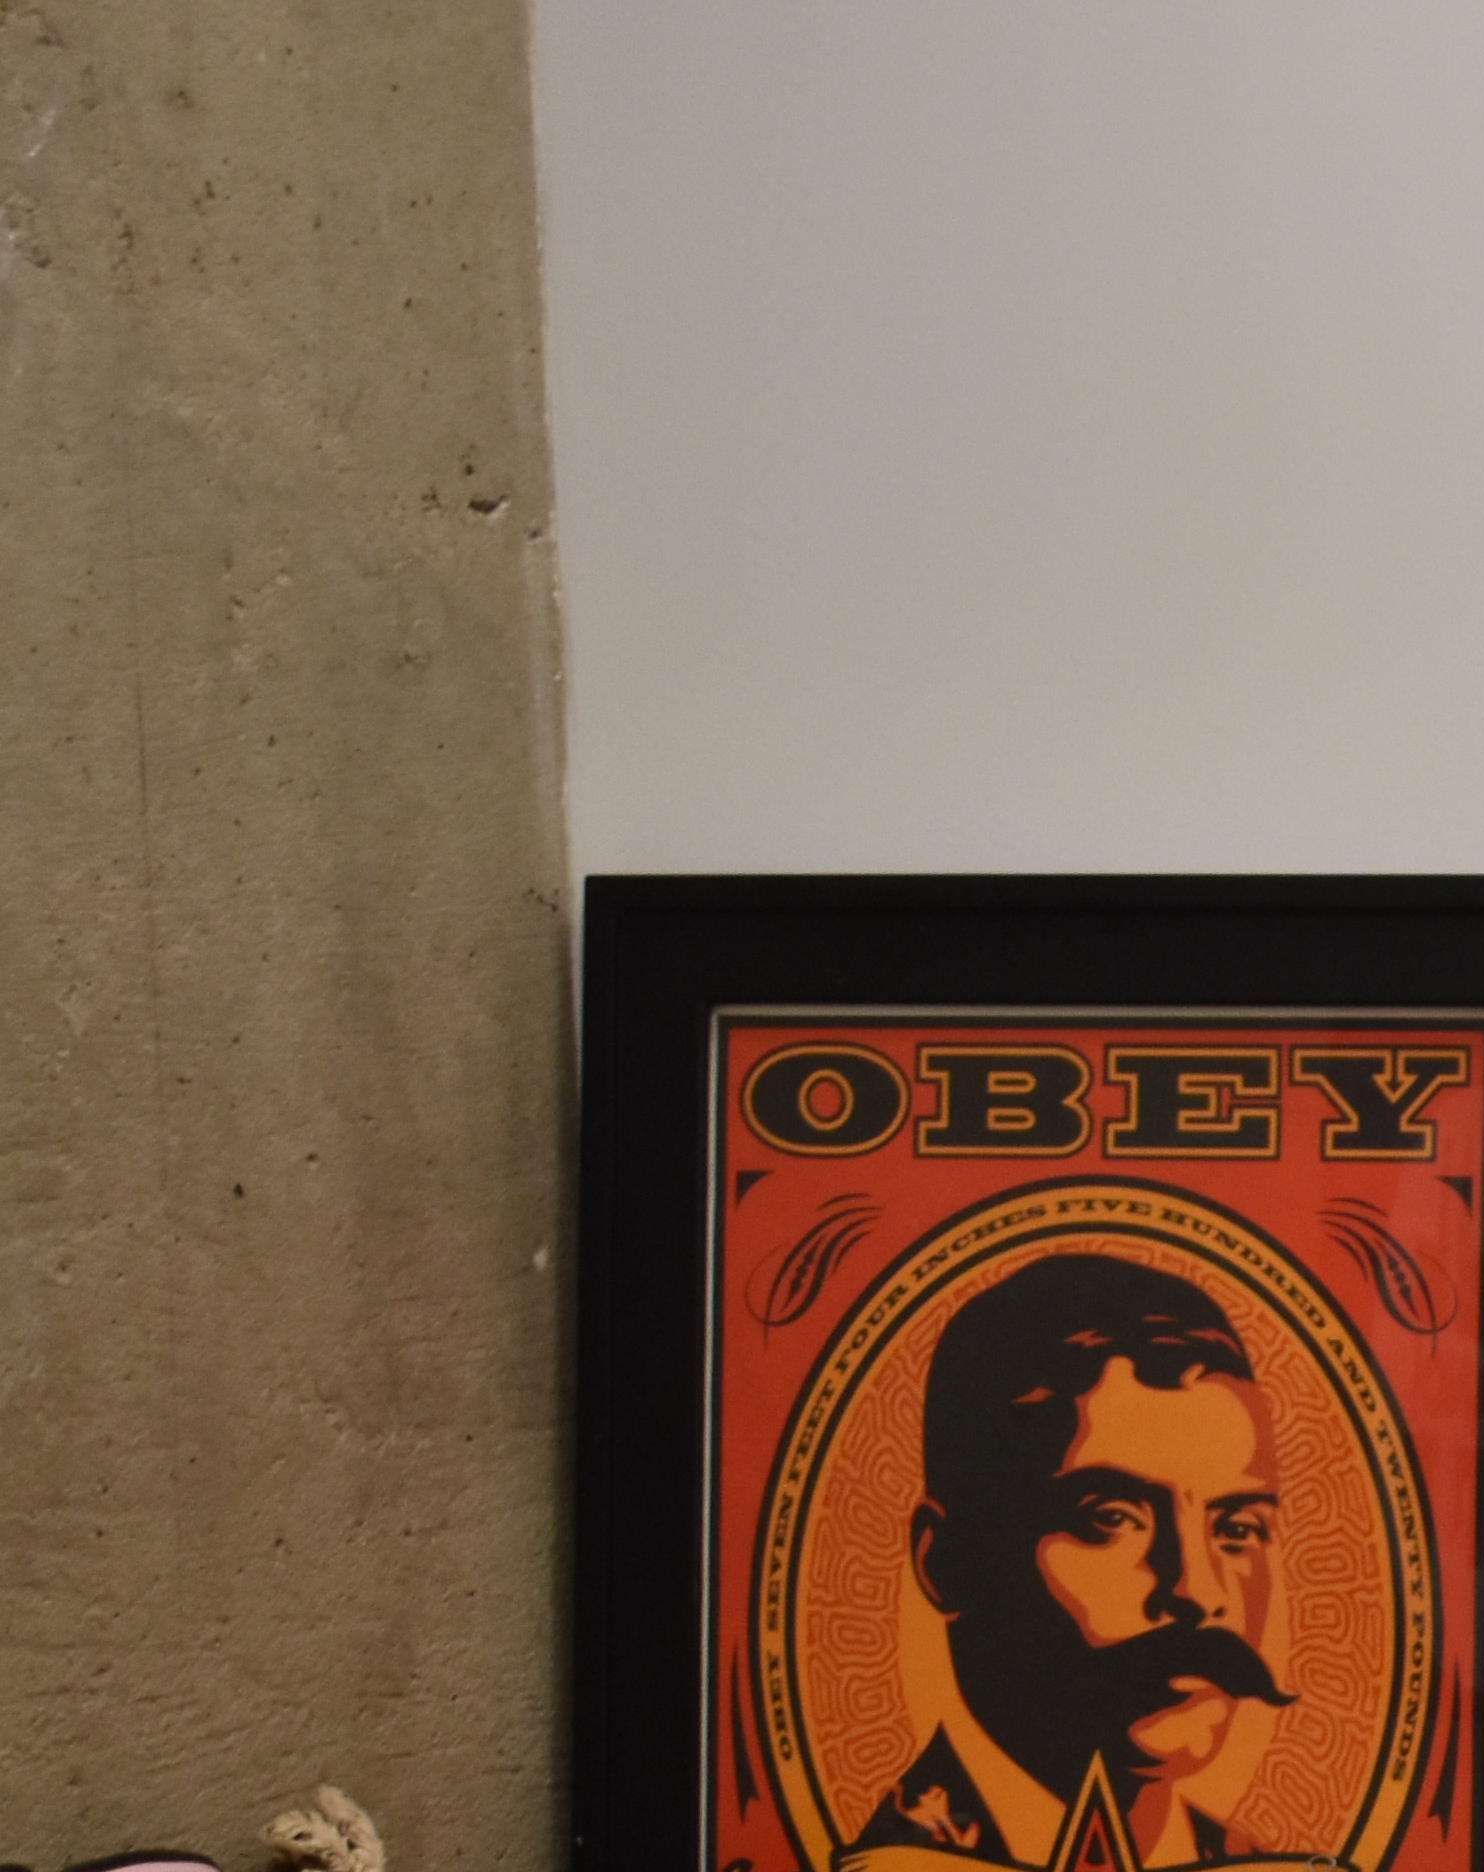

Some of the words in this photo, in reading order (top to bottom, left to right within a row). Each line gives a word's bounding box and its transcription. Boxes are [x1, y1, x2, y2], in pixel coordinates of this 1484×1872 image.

[740, 1040, 1472, 1161] OBEY
[910, 1202, 1047, 1283] INCHES
[1056, 1198, 1153, 1217] FIVE
[1160, 1205, 1327, 1331] HUNDRED
[834, 1282, 908, 1376] FOUR
[1328, 1338, 1378, 1414] AND
[790, 1380, 835, 1486] FEET
[766, 1495, 794, 1632] SEVEN
[1377, 1421, 1426, 1598] TWENTY
[1391, 1611, 1427, 1783] POUNDS
